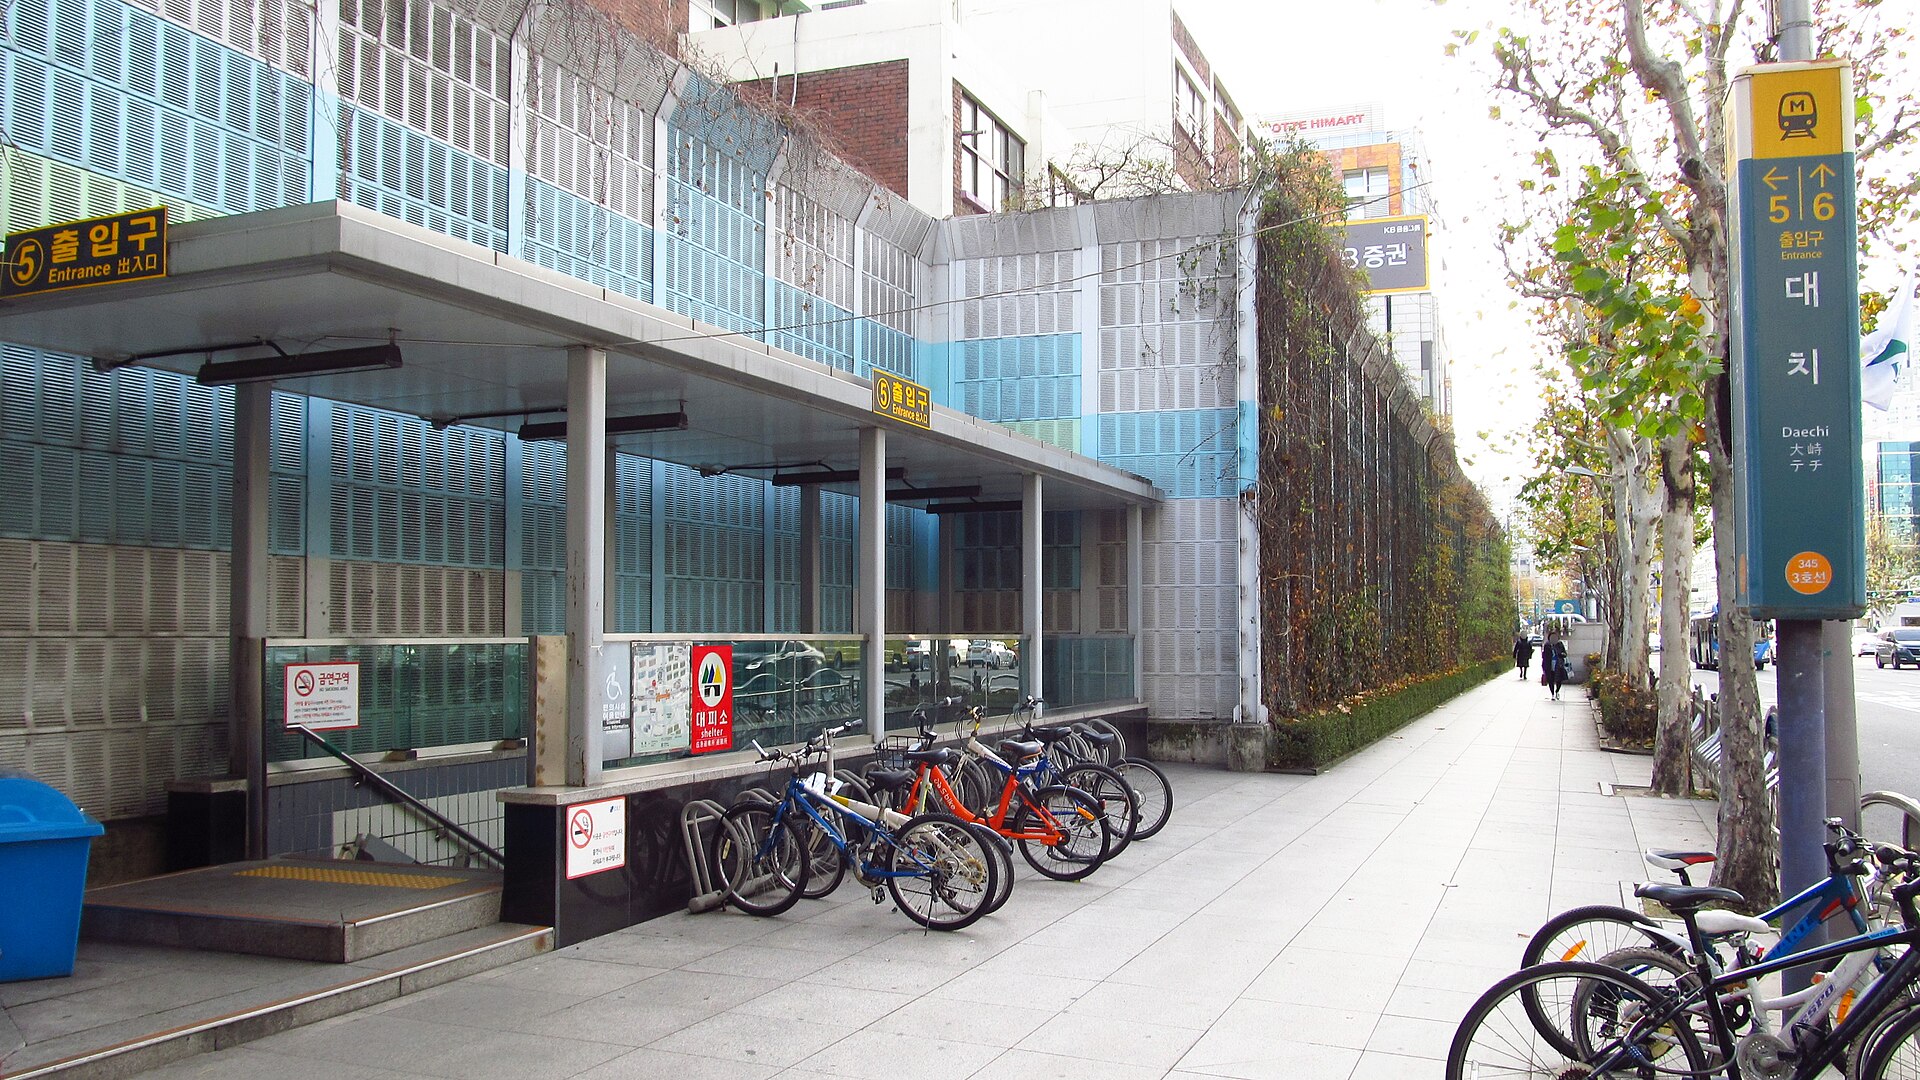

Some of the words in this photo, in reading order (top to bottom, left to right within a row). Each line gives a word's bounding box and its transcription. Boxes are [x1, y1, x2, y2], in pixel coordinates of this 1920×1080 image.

[1272, 121, 1307, 133] OTTE
[1311, 114, 1364, 129] HIMART
[1769, 195, 1790, 223] 5
[1812, 192, 1835, 221] 6
[51, 216, 157, 263] 출입구
[1779, 230, 1824, 248] 출입구
[1362, 242, 1407, 268] 증권
[1781, 250, 1822, 260] Entrance
[48, 263, 111, 283] Entrance
[117, 253, 157, 275] 出入口
[892, 382, 927, 411] 출입구
[892, 403, 915, 420] Entrance
[1782, 426, 1829, 438] Daechi
[1798, 560, 1818, 569] 345
[1791, 571, 1826, 584] 3호선
[318, 672, 349, 686] 금연구역
[696, 709, 728, 727] 대피소
[701, 727, 723, 738] shelter
